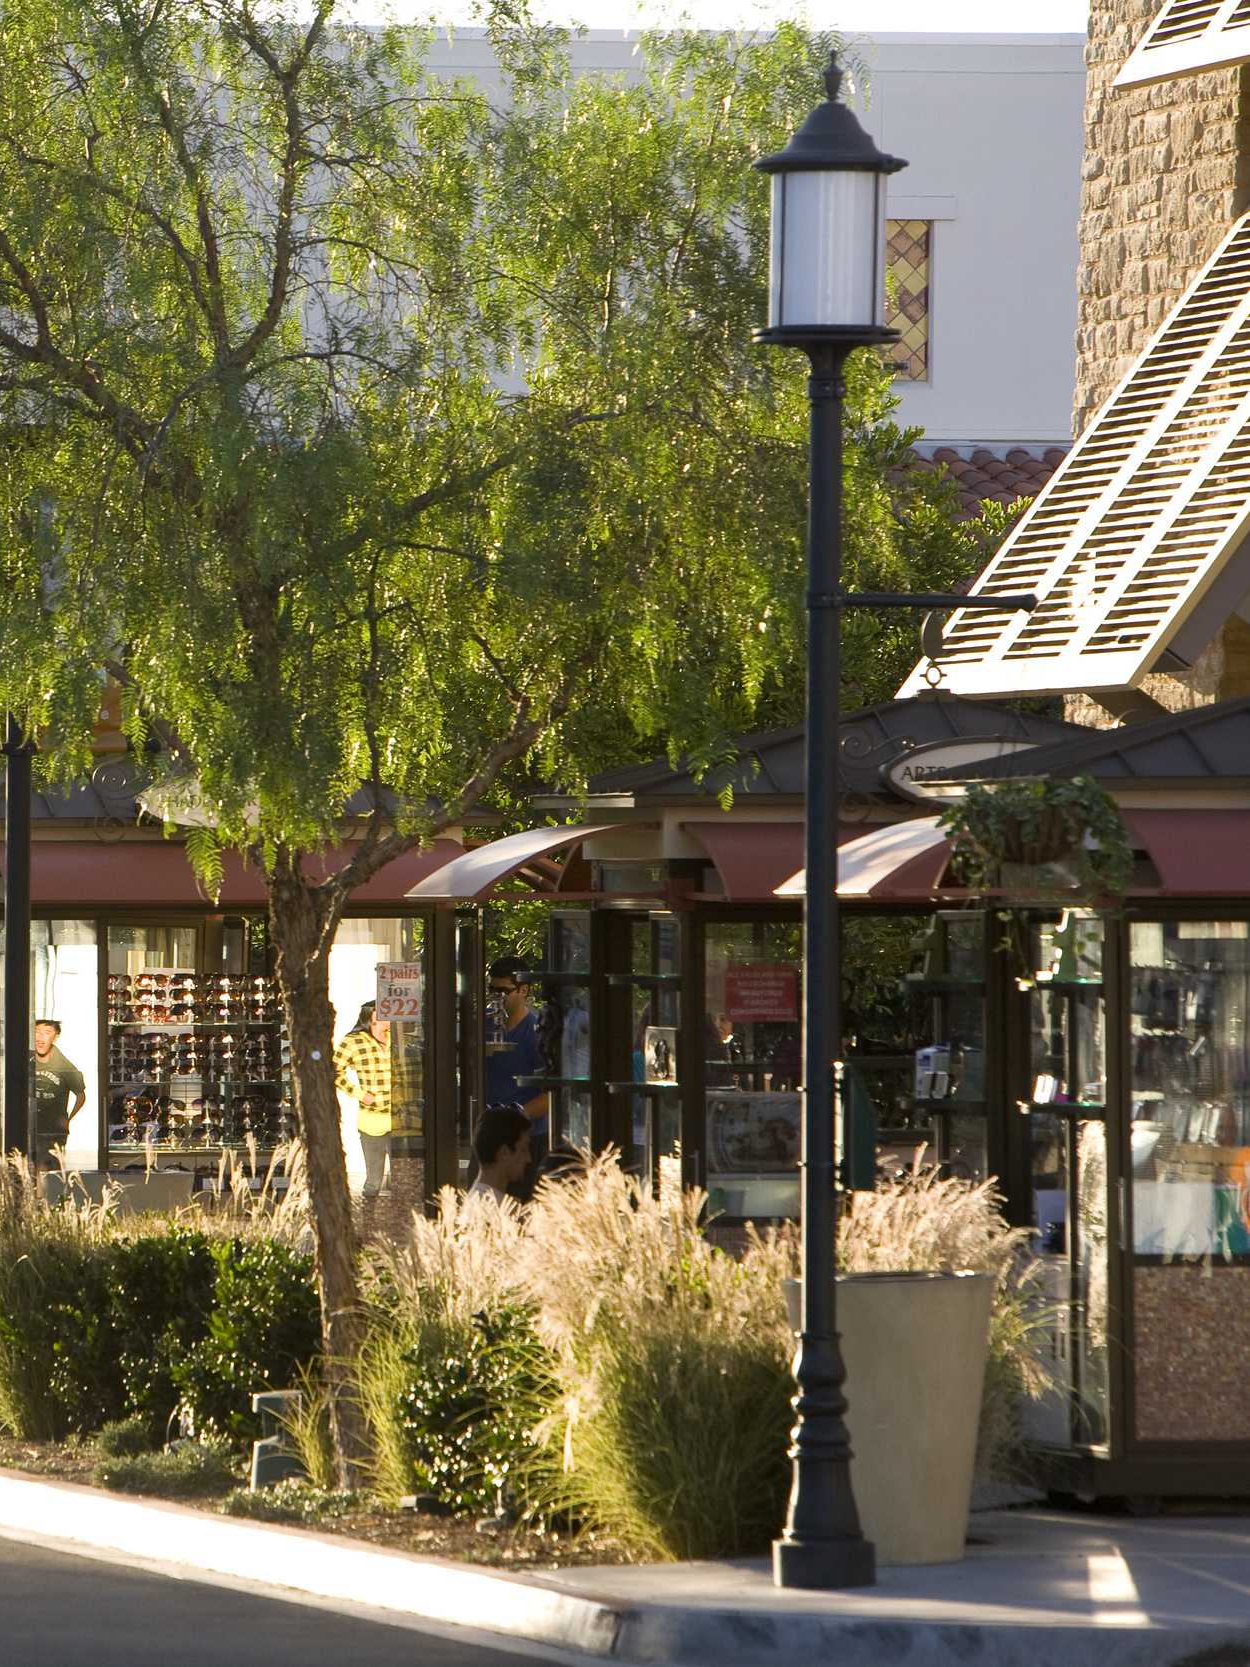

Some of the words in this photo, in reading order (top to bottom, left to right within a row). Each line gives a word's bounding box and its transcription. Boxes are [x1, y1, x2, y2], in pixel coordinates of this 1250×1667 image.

[379, 966, 386, 979] 2
[390, 966, 419, 981] pairs
[387, 984, 411, 997] for
[380, 998, 418, 1016] $22
